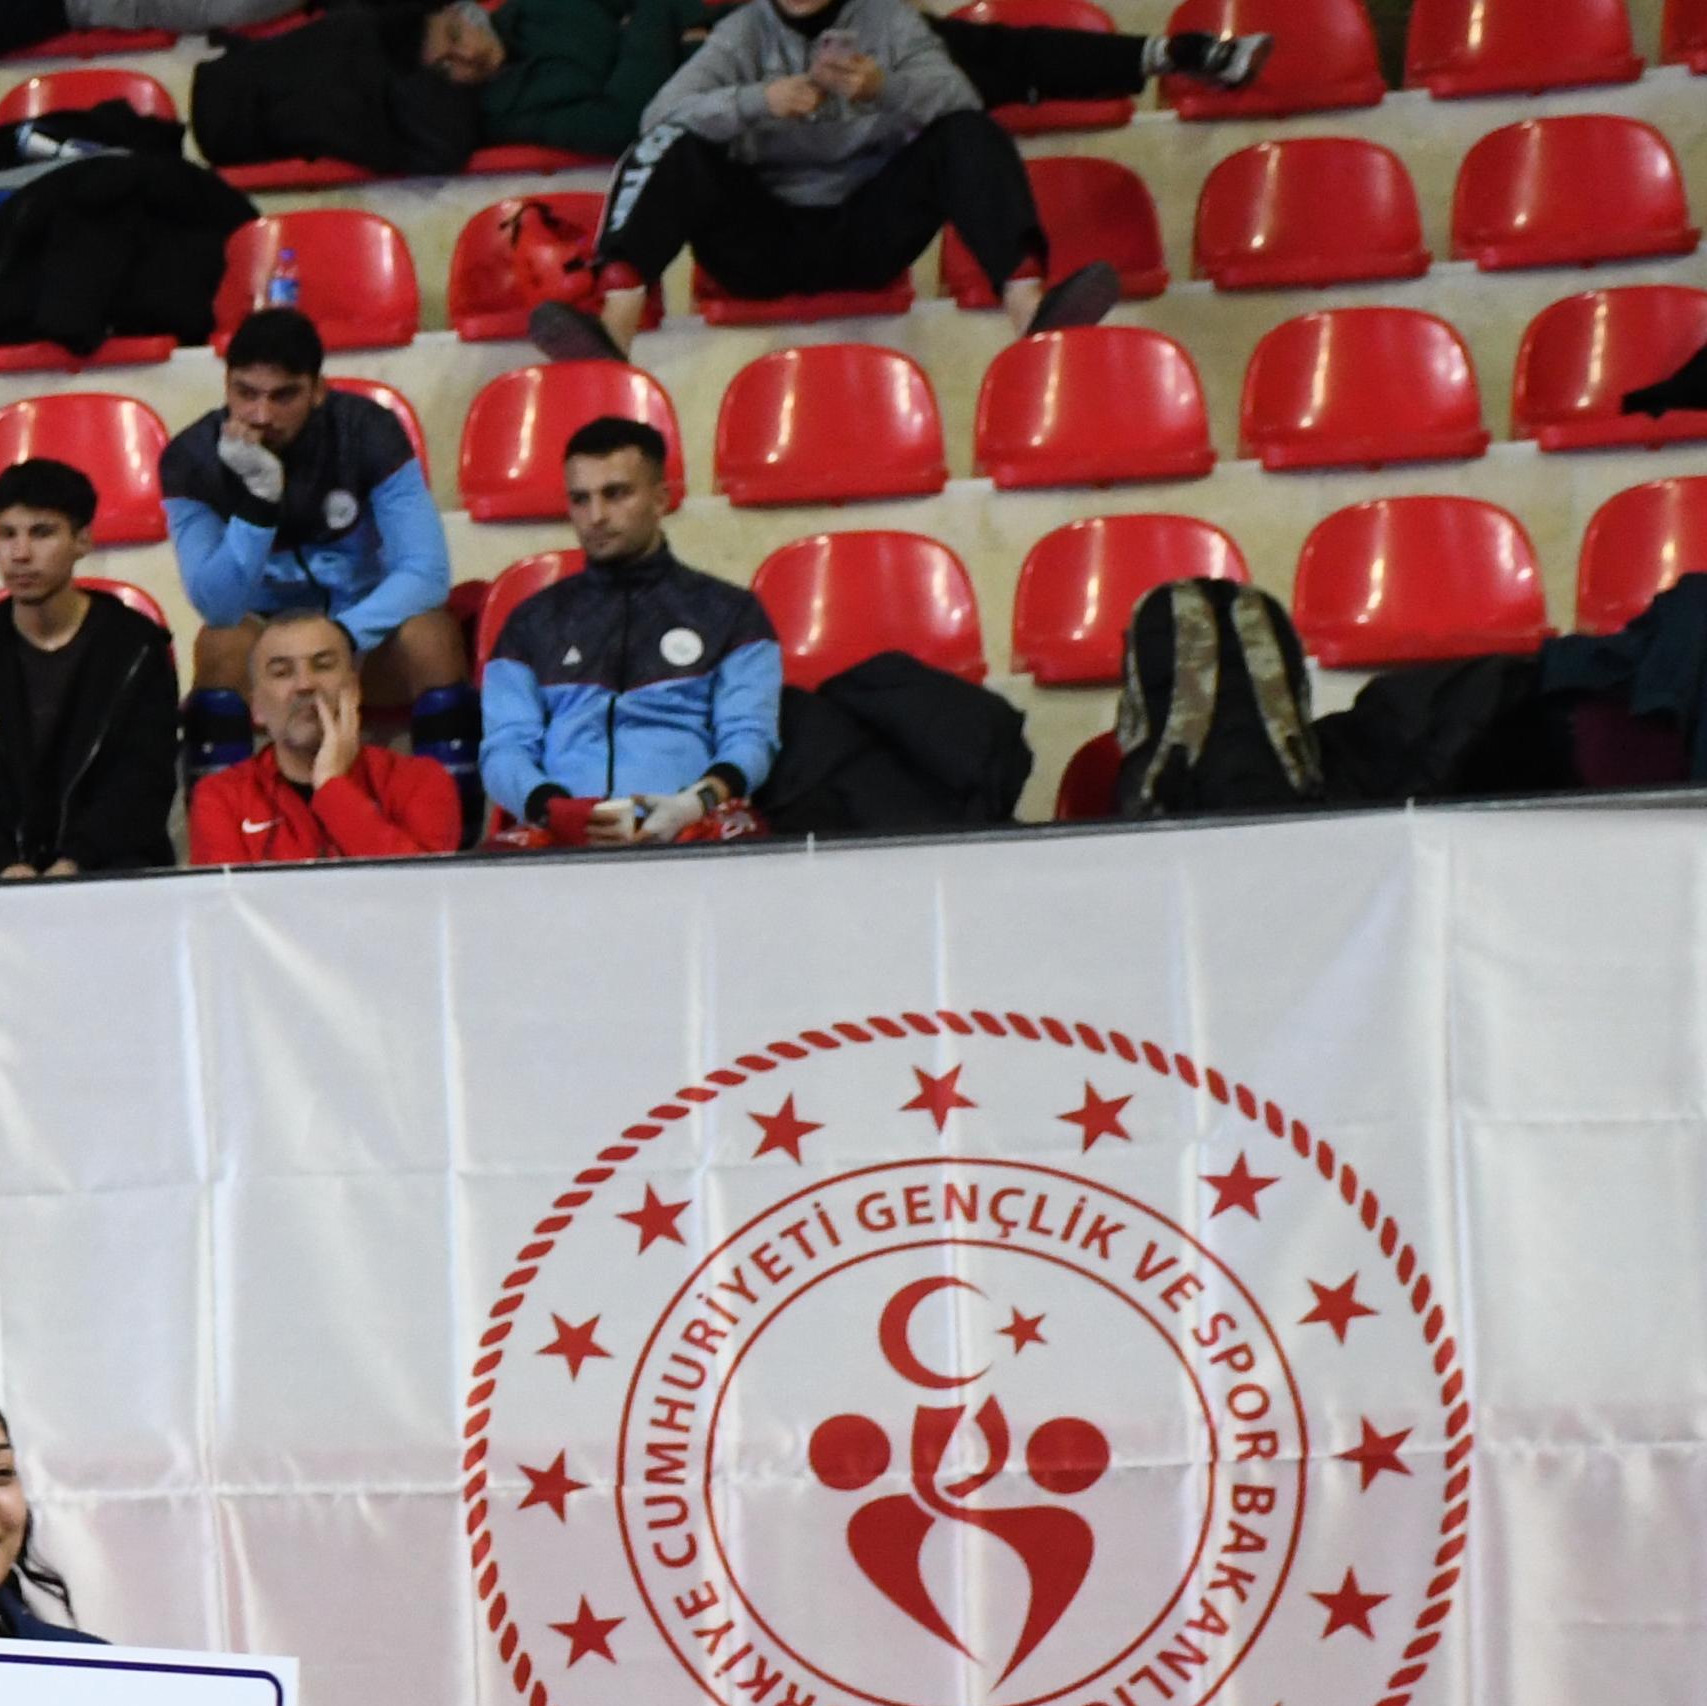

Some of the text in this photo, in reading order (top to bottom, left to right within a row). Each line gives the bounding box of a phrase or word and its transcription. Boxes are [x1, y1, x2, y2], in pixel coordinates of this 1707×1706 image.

[643, 1200, 843, 1570] CUMHURİYETİ
[855, 1183, 1128, 1261] GENÇLİK
[1133, 1240, 1206, 1314] VE
[1191, 1311, 1279, 1463] SPOR
